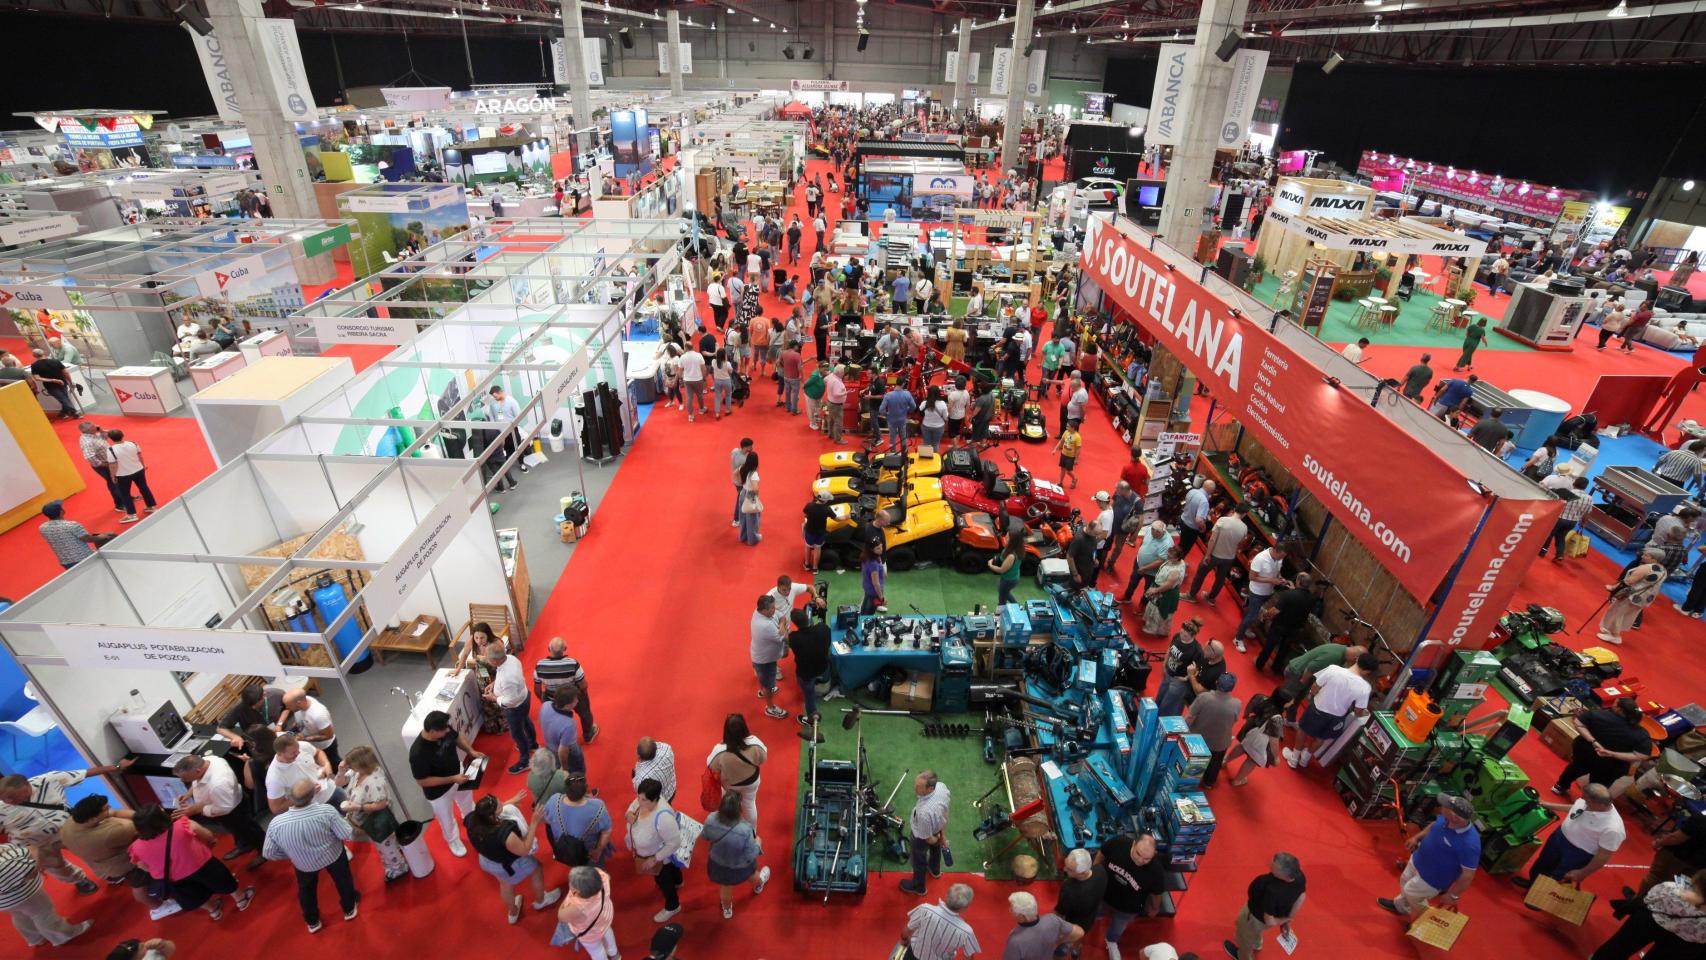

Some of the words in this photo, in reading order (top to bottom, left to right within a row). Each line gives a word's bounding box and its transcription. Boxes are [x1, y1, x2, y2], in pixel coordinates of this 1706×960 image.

[474, 95, 557, 115] ARAGÓN
[1310, 196, 1366, 211] MAXA
[1305, 226, 1328, 241] MAXA
[1349, 237, 1388, 248] MAXA
[1432, 242, 1470, 252] MAXA
[230, 266, 249, 281] Cuba
[15, 291, 43, 302] Cuba
[1100, 238, 1243, 393] SOUTELANA
[1257, 370, 1272, 387] Horta
[134, 391, 158, 401] Cuba
[1266, 393, 1286, 414] Natural
[1302, 453, 1412, 564] soutelana.com
[422, 541, 438, 562] POZOS
[395, 551, 419, 583] AUGAPLUS
[1448, 513, 1536, 646] soutelana.com
[97, 641, 147, 651] AUGAPLUS
[143, 653, 157, 661] DE
[158, 653, 191, 663] POZOS
